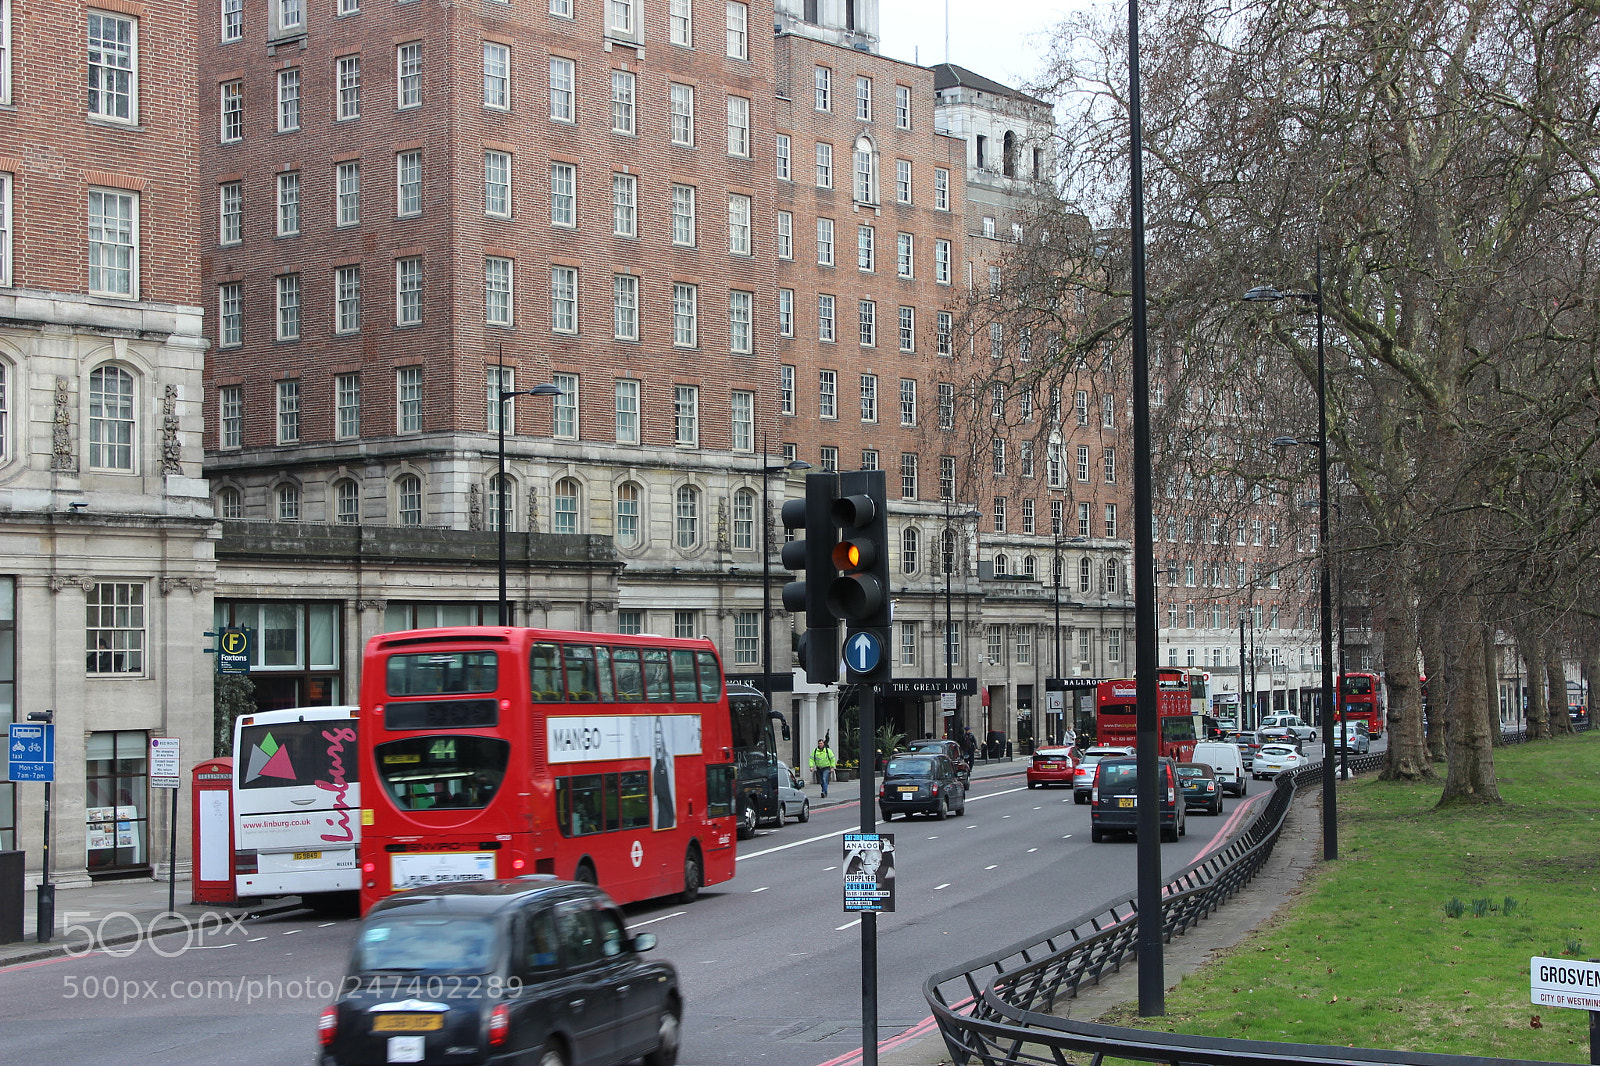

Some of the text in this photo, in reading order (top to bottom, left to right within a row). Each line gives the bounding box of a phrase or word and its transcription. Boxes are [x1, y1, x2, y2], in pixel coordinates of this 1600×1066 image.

[229, 633, 239, 651] F
[221, 654, 247, 662] Foxtons
[893, 683, 910, 692] THE
[913, 683, 940, 692] GREAT
[553, 727, 600, 751] MANGO
[314, 727, 357, 842] Linburg
[243, 818, 311, 830] www.linburg.co.uk
[1540, 966, 1600, 988] GROSVEN
[1540, 993, 1554, 1002] CITY
[1556, 995, 1564, 1003] OF
